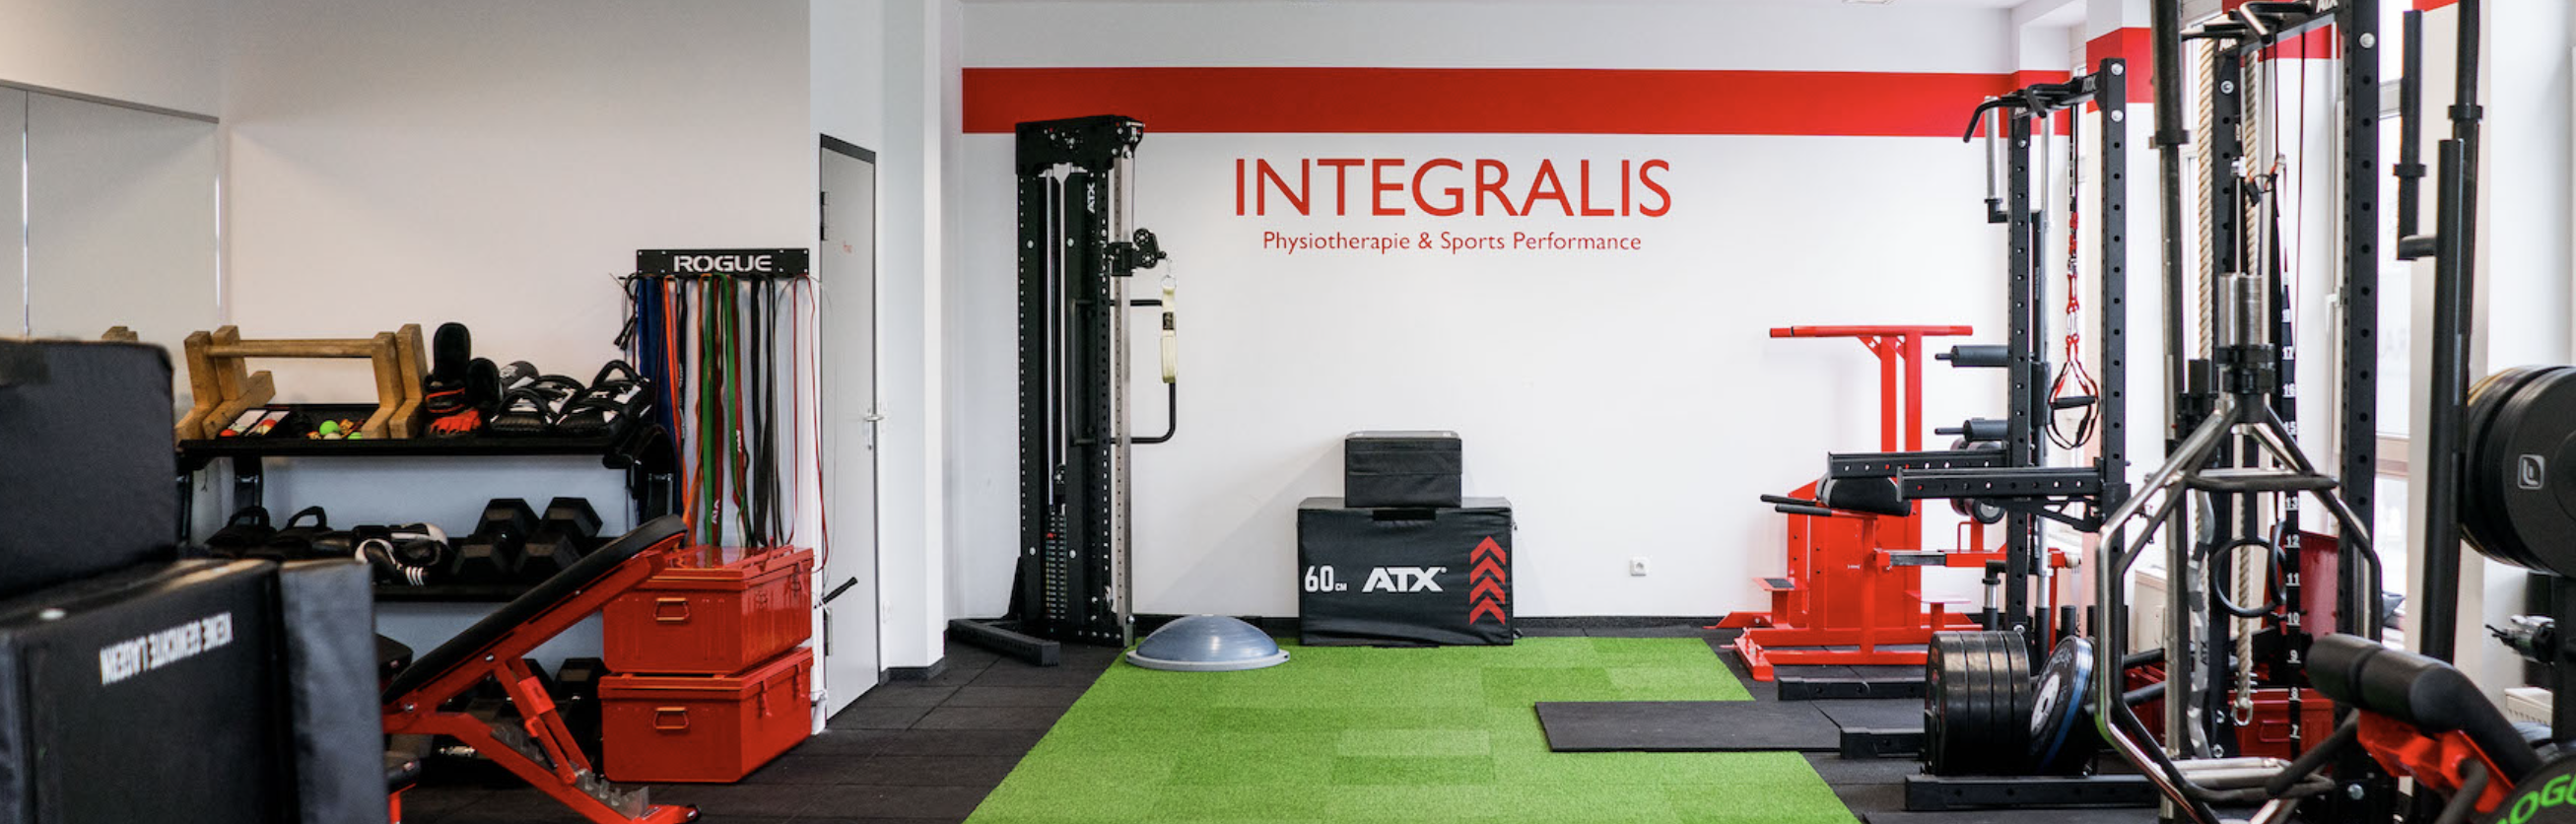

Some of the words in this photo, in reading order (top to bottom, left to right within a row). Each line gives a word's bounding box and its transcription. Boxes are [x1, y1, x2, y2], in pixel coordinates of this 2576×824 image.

[1236, 158, 1671, 217] INTEGRALIS
[1087, 182, 1096, 214] ATX
[1263, 231, 1410, 255] Physiotherapie
[1417, 232, 1433, 249] &
[1441, 231, 1505, 255] Sports
[1513, 231, 1642, 250] Performance
[673, 254, 772, 272] ROGUE
[2286, 497, 2299, 509] 13
[2286, 534, 2300, 546] 12
[2287, 573, 2300, 584] 11
[2287, 612, 2300, 624] 10
[2289, 650, 2298, 661] 9
[2291, 724, 2299, 736] 7
